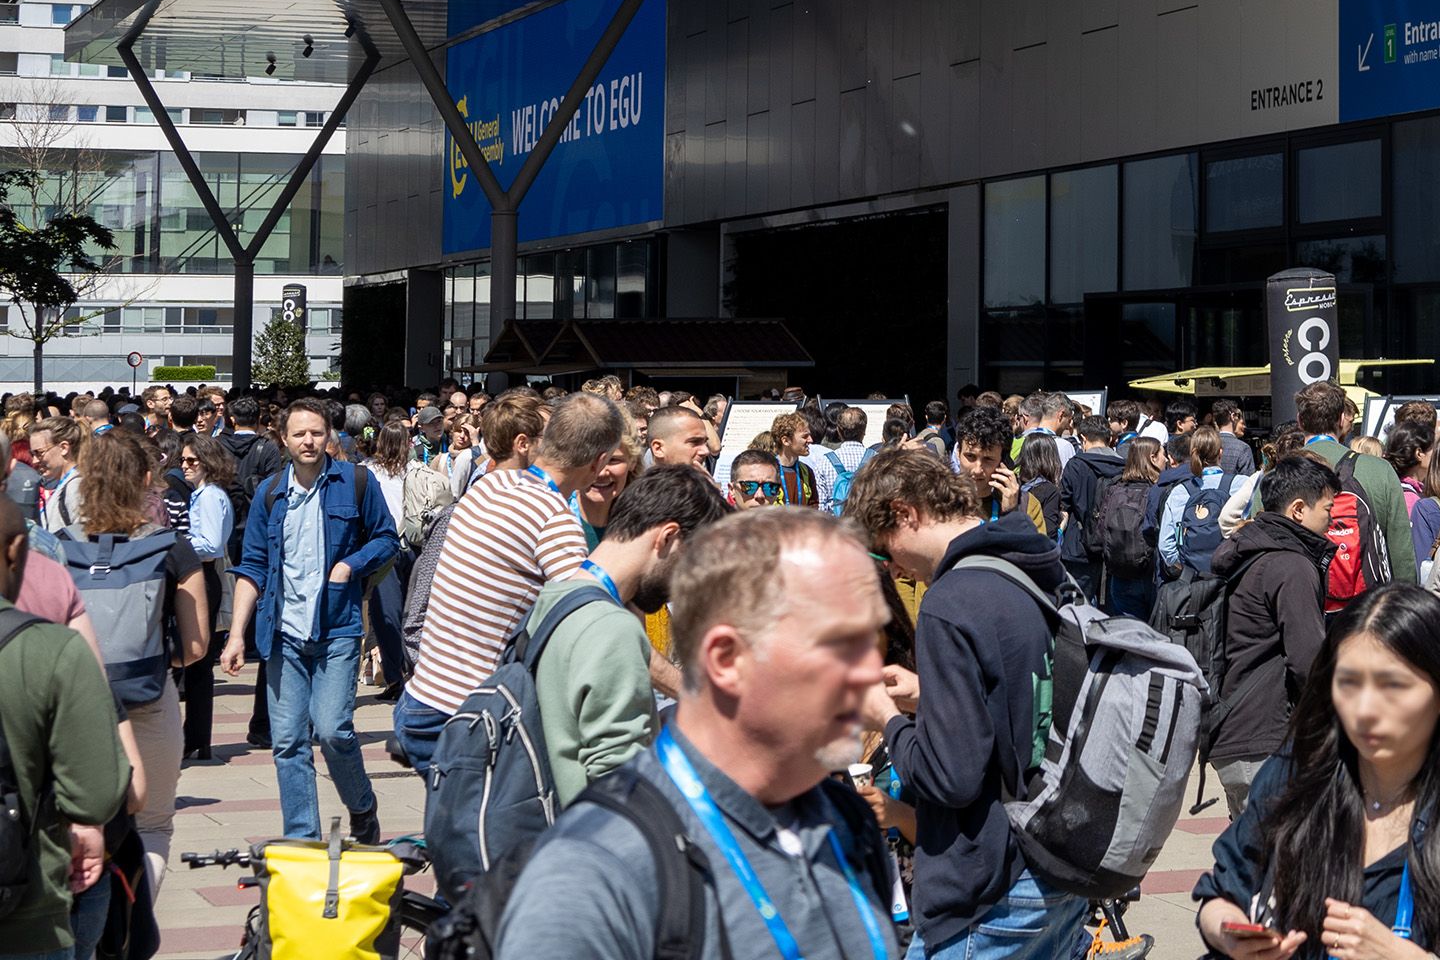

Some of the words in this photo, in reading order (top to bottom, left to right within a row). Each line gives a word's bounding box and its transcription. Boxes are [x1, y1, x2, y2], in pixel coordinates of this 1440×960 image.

[1387, 39, 1393, 58] 1
[1404, 50, 1418, 65] with
[1419, 48, 1438, 62] name
[585, 83, 606, 136] TO
[609, 72, 642, 131] EGU
[1251, 80, 1313, 111] ENTRANCE
[1316, 79, 1323, 100] 2
[477, 113, 499, 141] General
